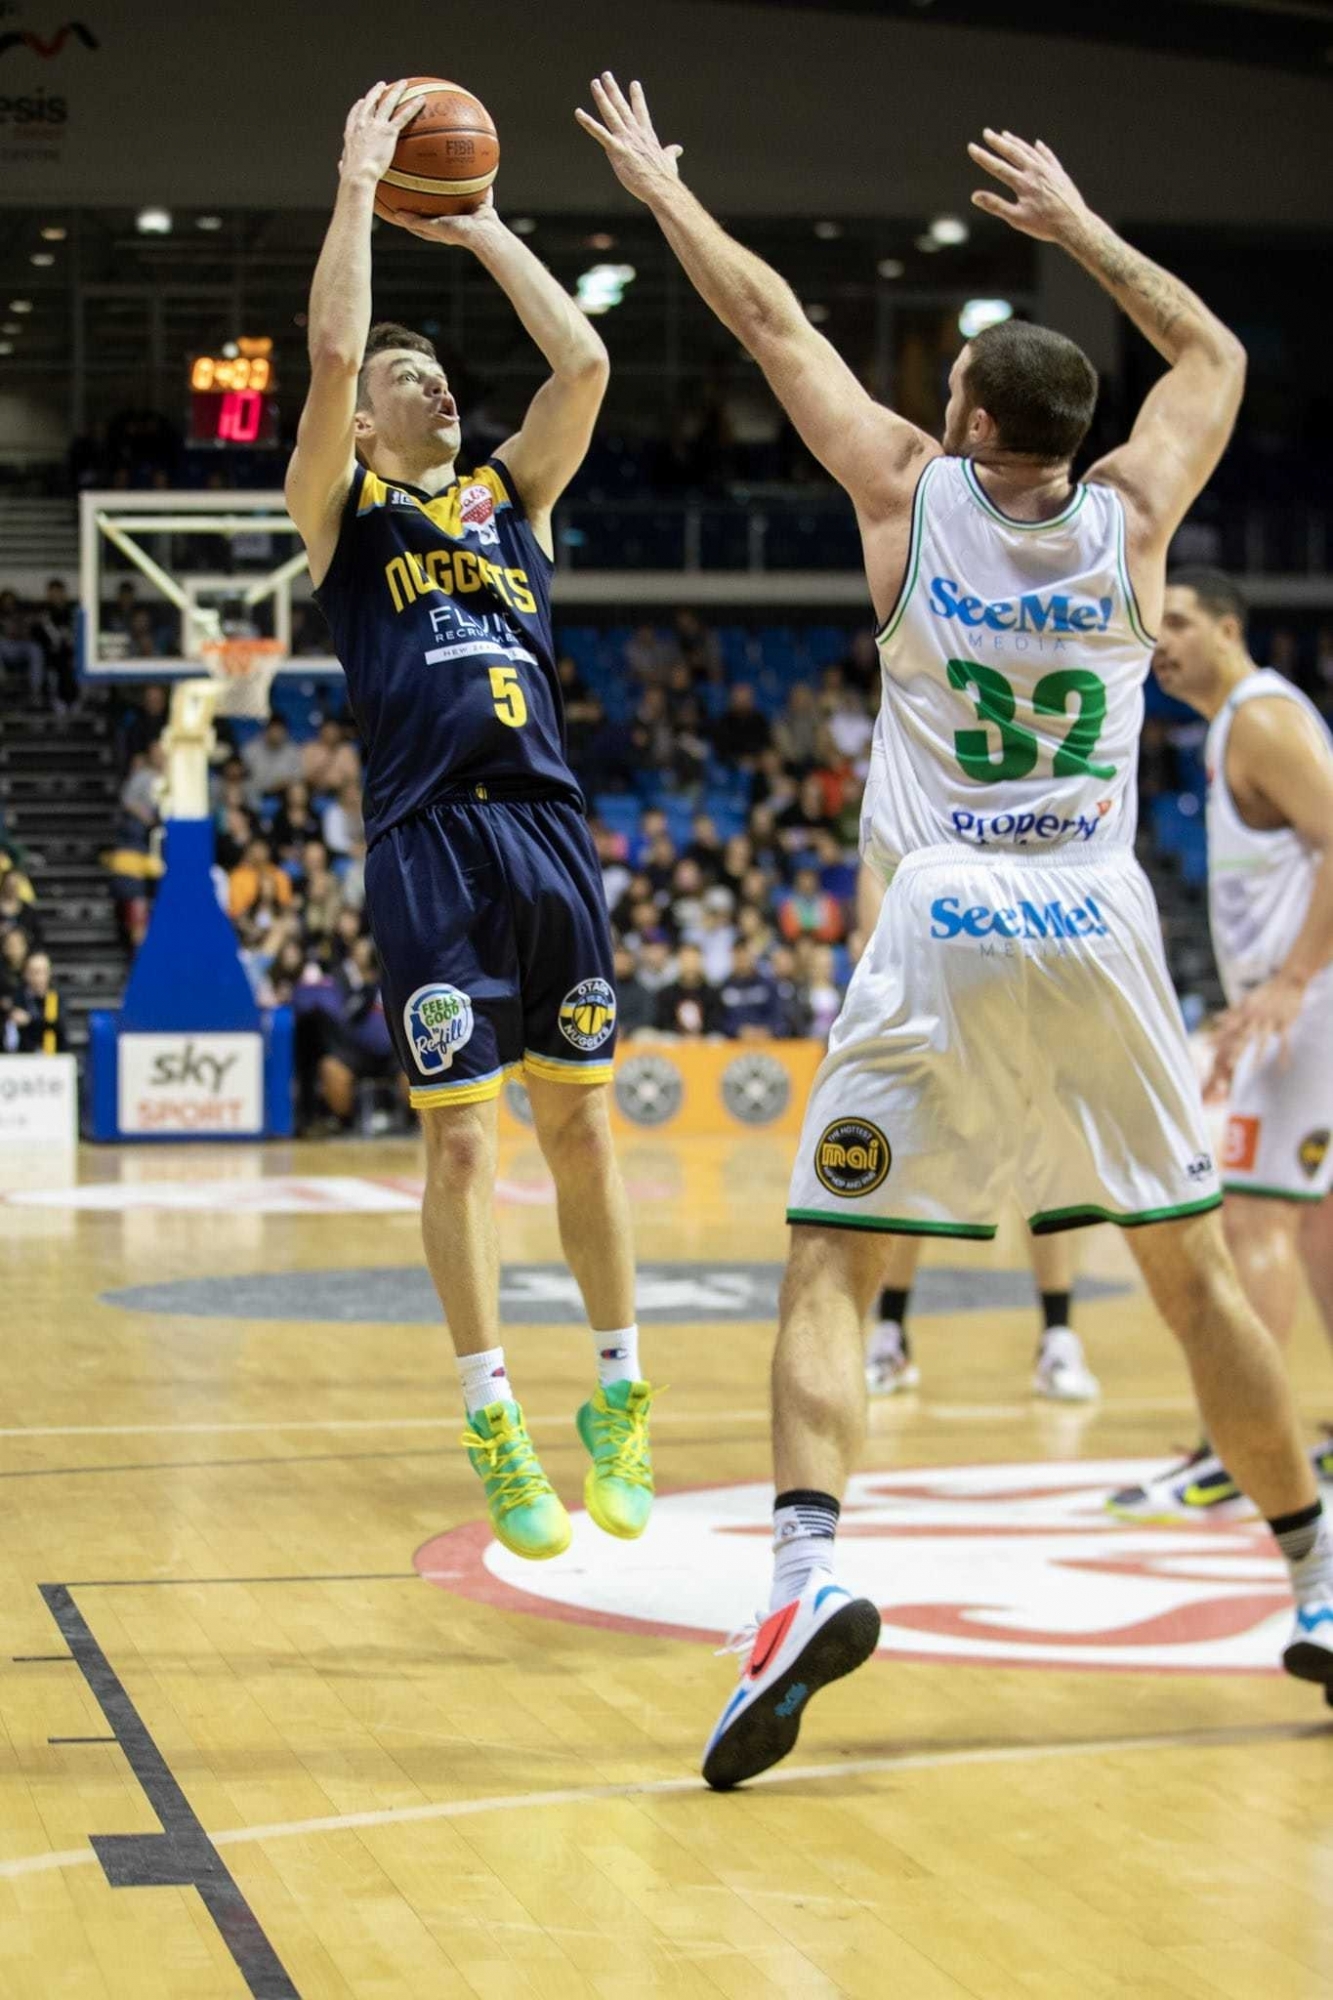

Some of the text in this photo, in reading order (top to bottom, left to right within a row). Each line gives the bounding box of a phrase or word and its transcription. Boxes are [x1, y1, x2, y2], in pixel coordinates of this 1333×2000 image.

[446, 140, 475, 156] FIBA
[930, 576, 1113, 632] SeeMe!
[969, 633, 1066, 651] MEDIA
[489, 667, 528, 728] 5
[946, 658, 1117, 783] 32
[952, 810, 1101, 842] Property
[930, 896, 1108, 941] SeeMe!
[422, 995, 457, 1016] FEELS
[425, 1005, 460, 1027] GOOD
[415, 1019, 462, 1055] Refill
[148, 1039, 238, 1094] sky
[137, 1099, 242, 1126] SPORT
[821, 1138, 879, 1170] mai
